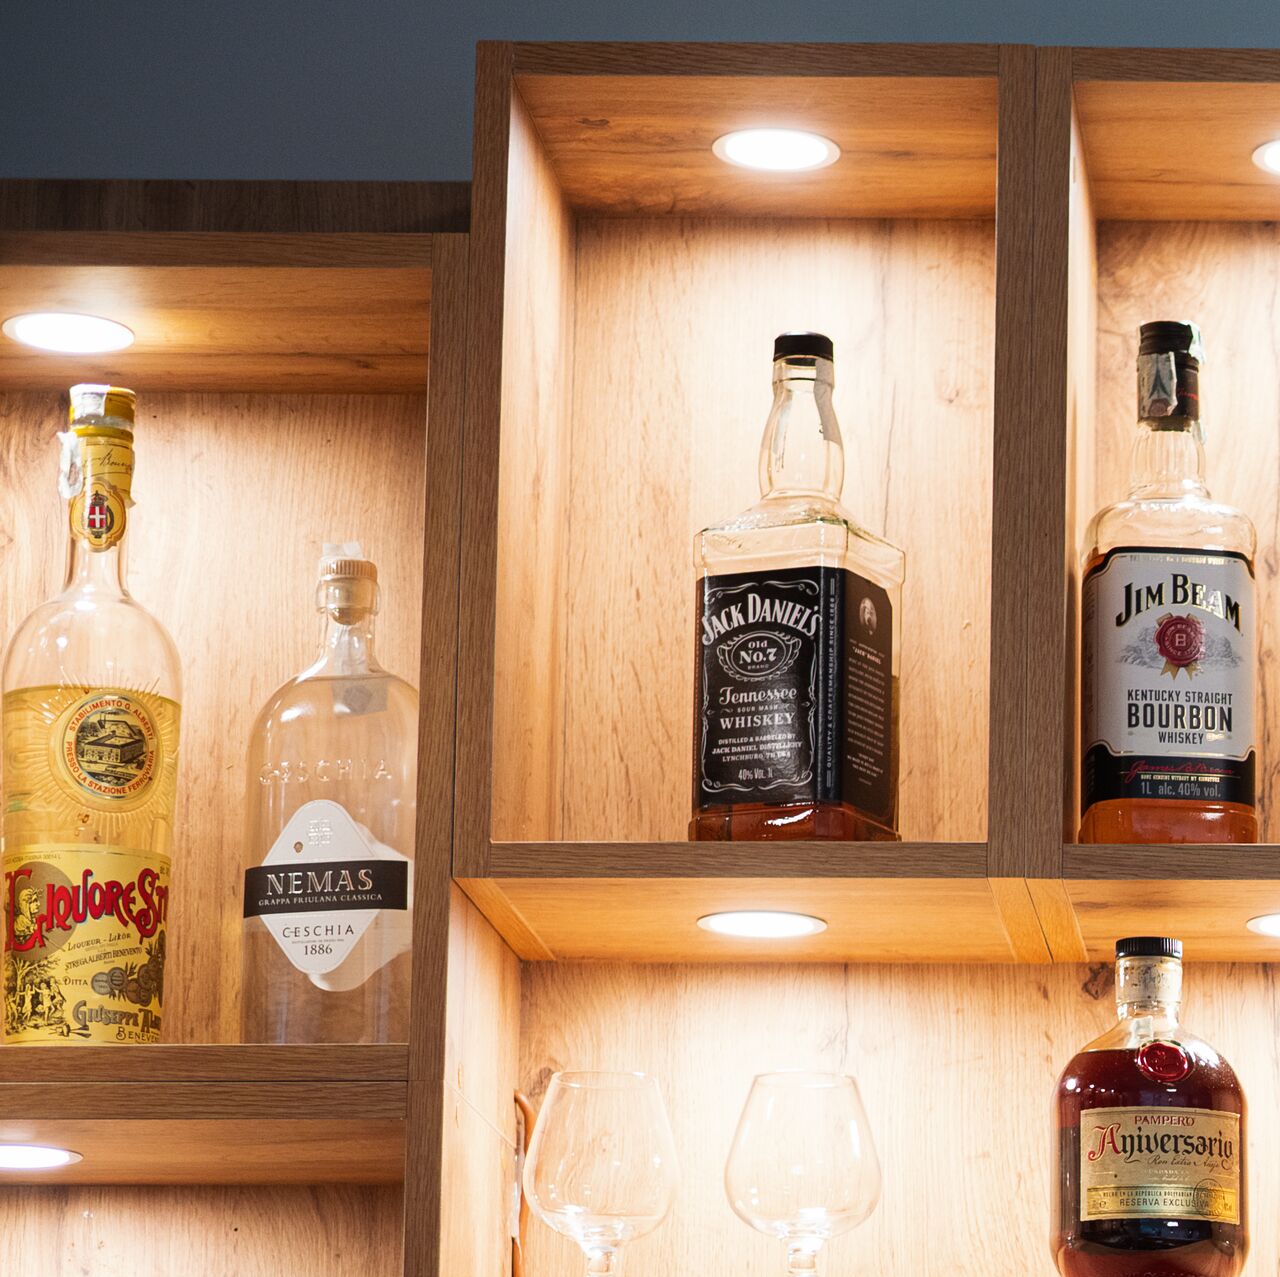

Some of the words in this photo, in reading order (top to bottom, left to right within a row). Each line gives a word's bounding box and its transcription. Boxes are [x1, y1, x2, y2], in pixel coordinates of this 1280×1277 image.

[1115, 582, 1165, 627] JIM
[1171, 573, 1241, 632] BEAM
[702, 603, 745, 646] JACK
[748, 593, 822, 636] DANIEL'S
[748, 640, 768, 649] Old
[739, 647, 778, 664] No.7
[719, 687, 797, 705] Tennessee
[1128, 689, 1181, 703] KENTUCKY
[1185, 691, 1233, 705] STRAIGHT
[69, 700, 123, 732] STABILIMENTO
[133, 709, 154, 740] ALBERTI
[720, 712, 796, 730] WHISKEY
[1128, 703, 1232, 732] BOURBON
[1158, 731, 1204, 744] WHISKEY
[712, 747, 730, 755] JACK
[731, 745, 758, 753] DANIEL
[66, 741, 79, 773] PRESSO
[77, 772, 87, 784] LA
[88, 780, 128, 795] STAZIONE
[127, 750, 154, 793] FERROVIARIA
[1158, 782, 1176, 795] alc.
[1178, 782, 1201, 796] 40%
[1203, 783, 1221, 797] vol.
[266, 869, 373, 896] NEMAS
[259, 898, 290, 907] GRAPPA
[294, 895, 338, 904] FRIULANA
[340, 893, 383, 902] CLASSICA
[282, 924, 355, 939] CESCHIA
[67, 938, 101, 952] LIQUEUR
[304, 944, 333, 956] 1886
[64, 976, 88, 986] DITTA
[1134, 1115, 1195, 1127] PAMPERO
[1088, 1123, 1233, 1163] Aniversario
[1147, 1154, 1168, 1166] Ron
[1119, 1198, 1160, 1207] RESERVA
[1163, 1198, 1210, 1208] EXCLUSIVA
